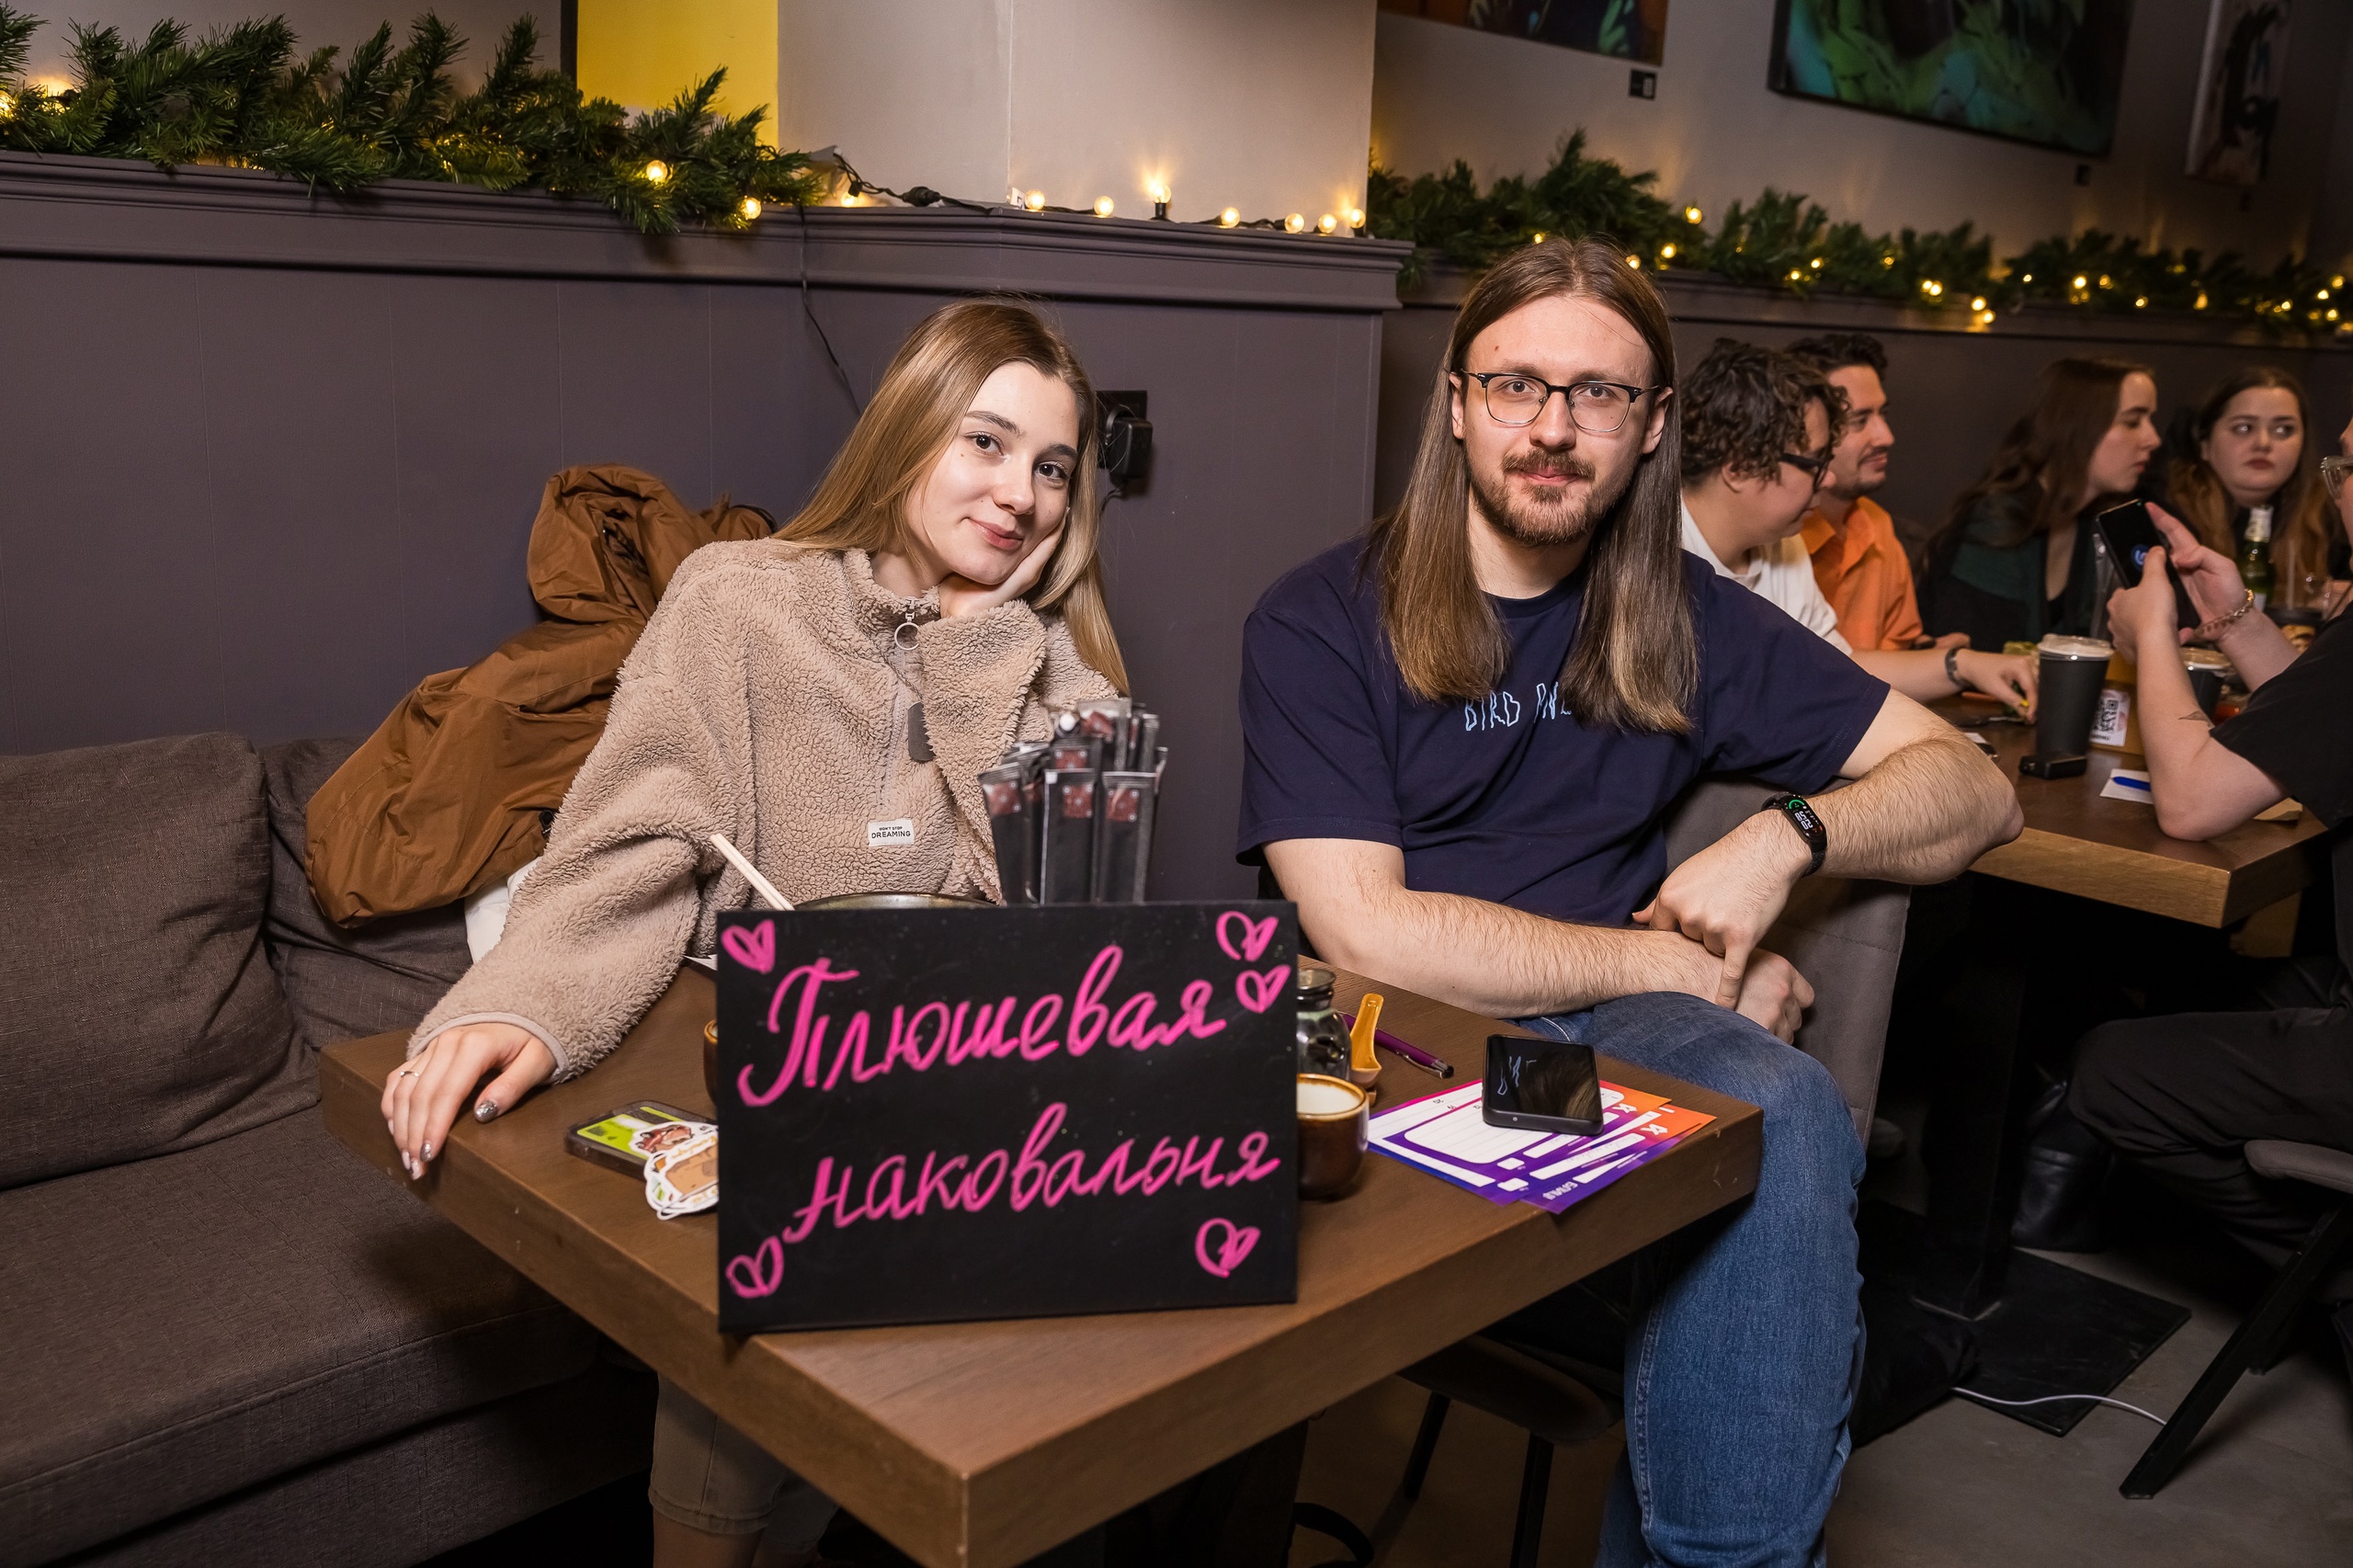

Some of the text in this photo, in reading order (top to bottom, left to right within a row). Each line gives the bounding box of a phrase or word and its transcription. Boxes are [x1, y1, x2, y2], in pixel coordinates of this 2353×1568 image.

[1464, 689, 1521, 732] BIRD
[871, 830, 911, 839] DREAMING
[738, 946, 1226, 1105] Плюшевая
[783, 1104, 1279, 1241] наковальня
